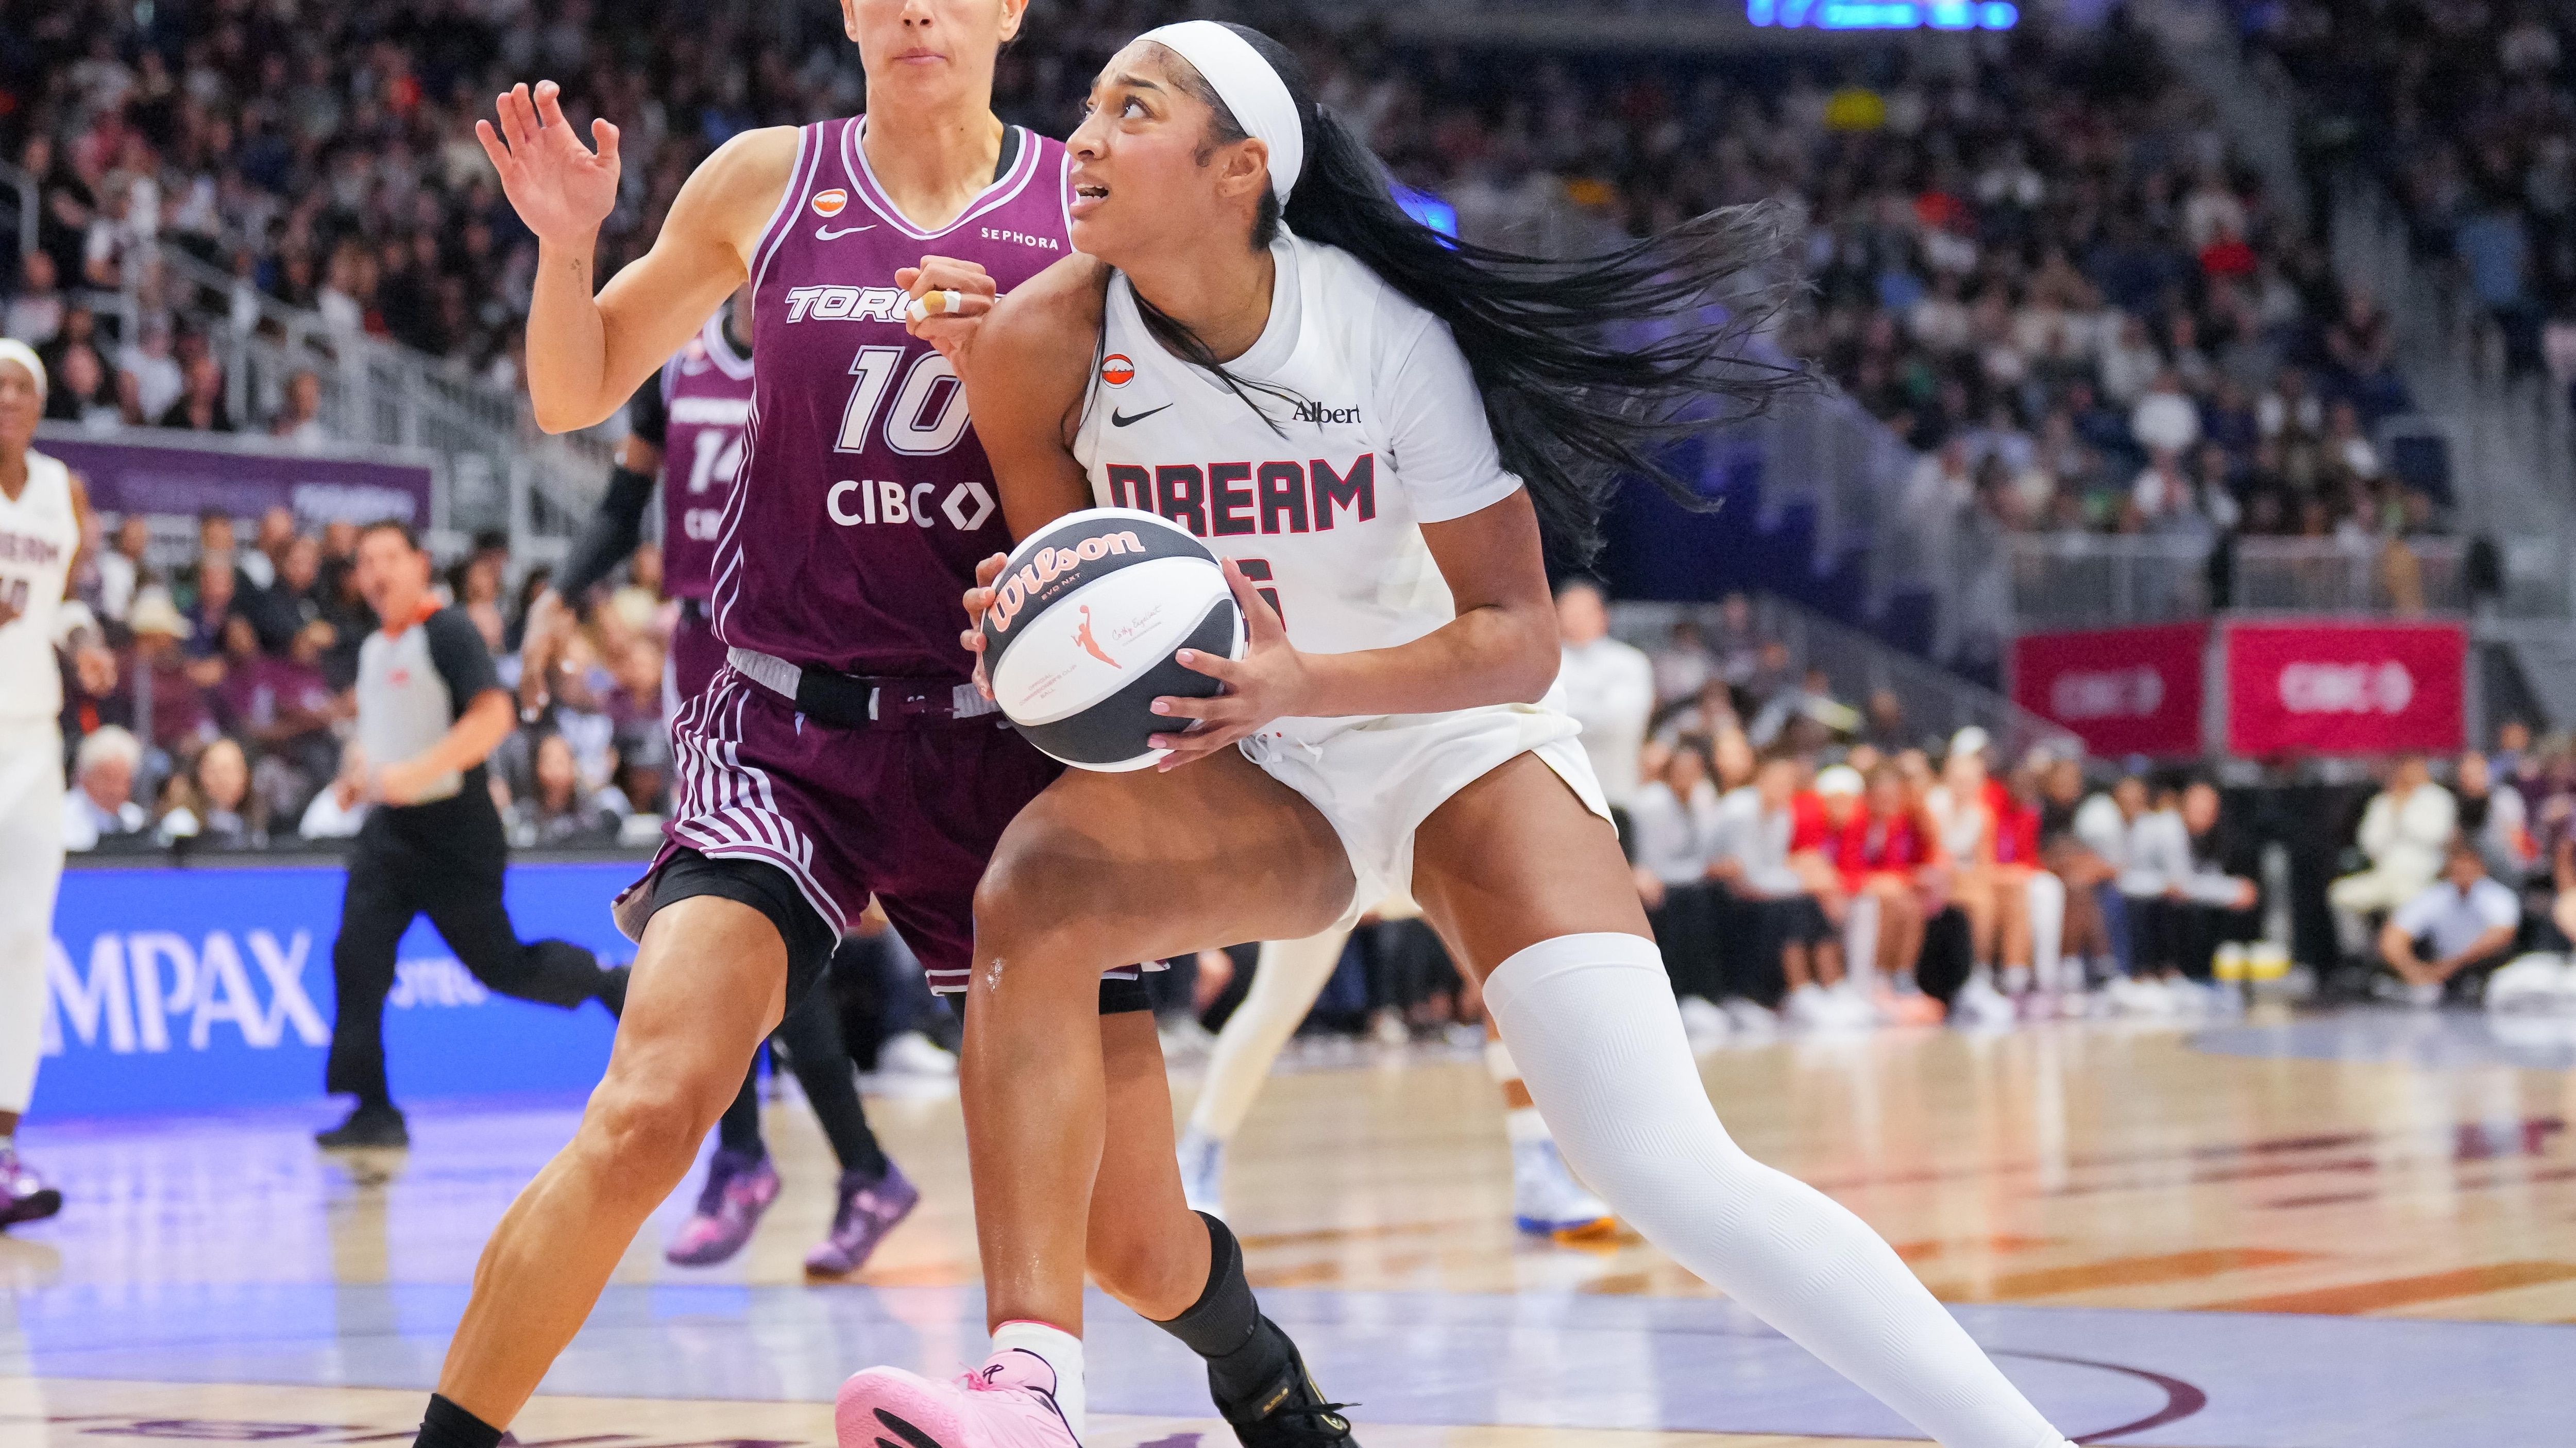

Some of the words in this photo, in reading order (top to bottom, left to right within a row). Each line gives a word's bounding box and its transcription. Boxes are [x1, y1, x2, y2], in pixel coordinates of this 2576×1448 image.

[981, 227, 1059, 250] SEPHORA
[833, 345, 972, 457] 10
[1292, 400, 1362, 424] Albert
[826, 479, 935, 529] CIBC
[1106, 452, 1376, 538] DREAM
[988, 530, 1146, 633] Wilson
[1061, 572, 1081, 586] NXT
